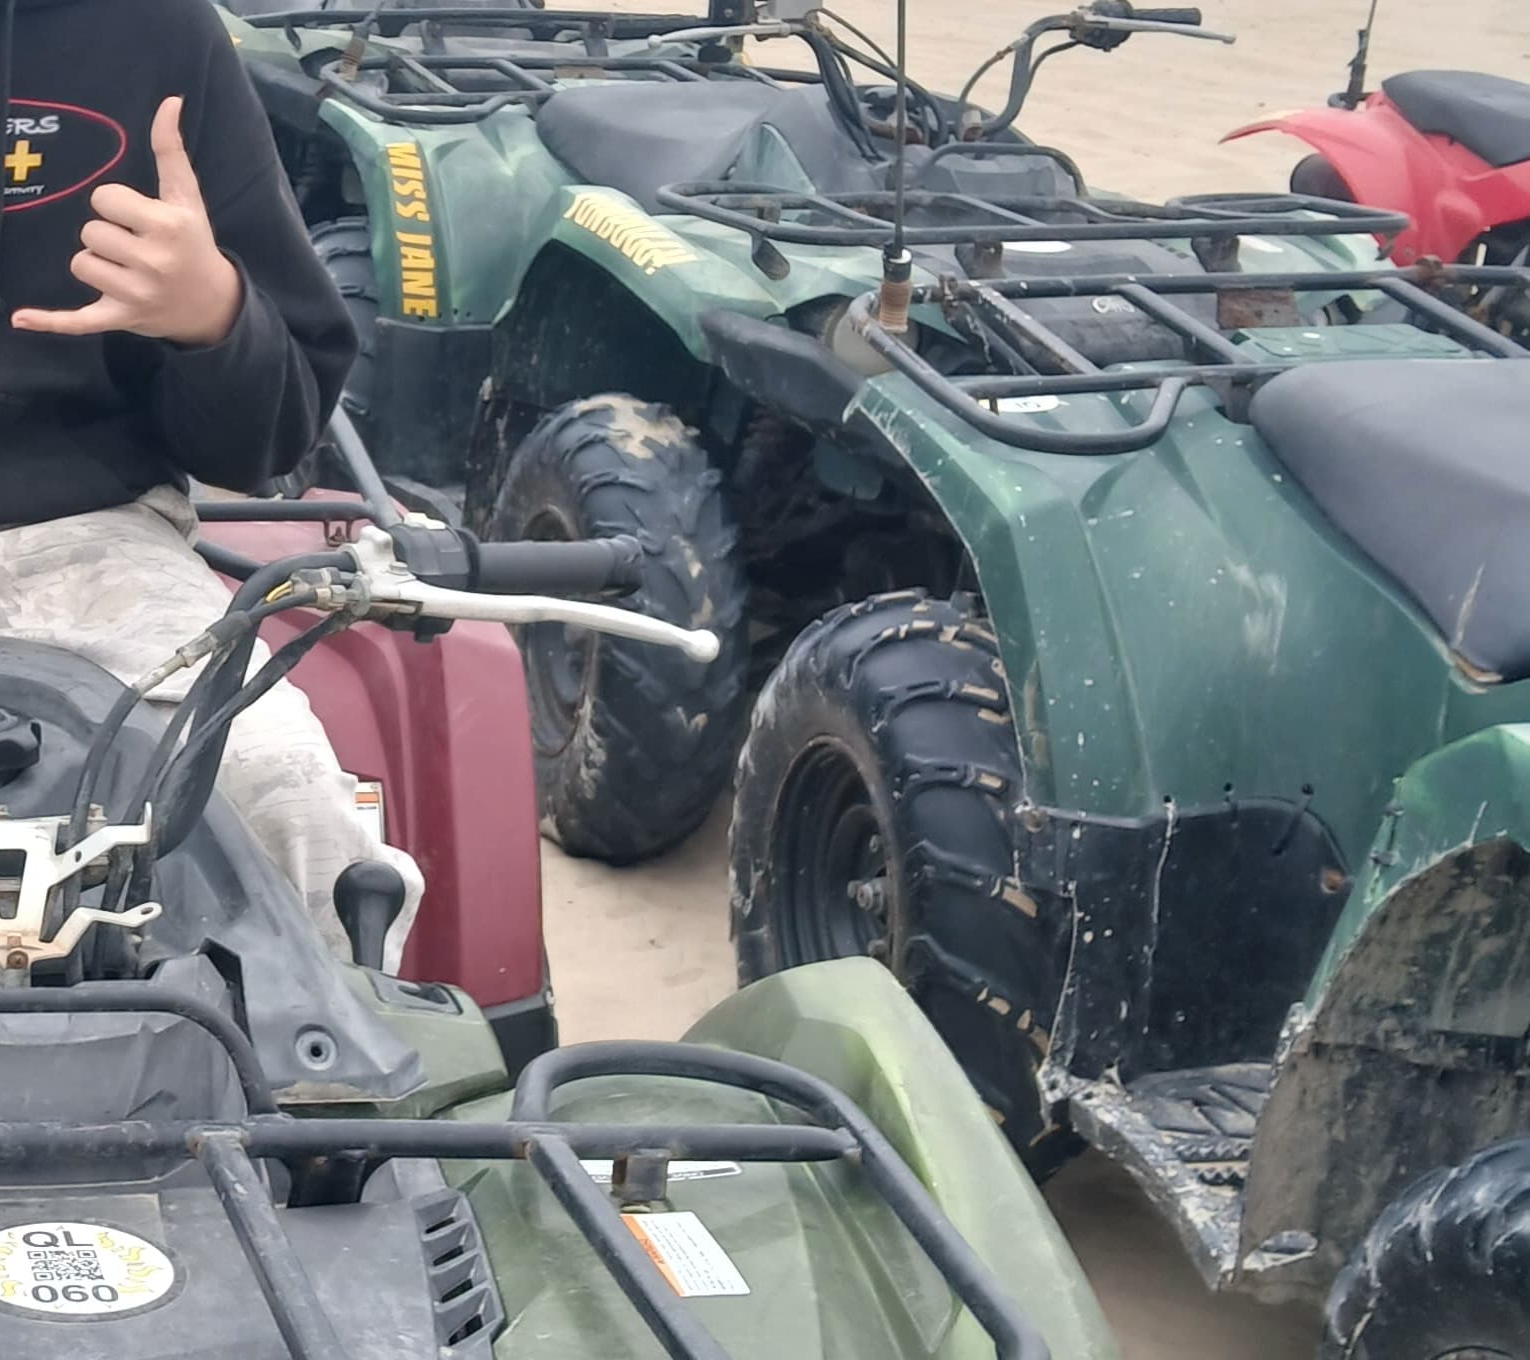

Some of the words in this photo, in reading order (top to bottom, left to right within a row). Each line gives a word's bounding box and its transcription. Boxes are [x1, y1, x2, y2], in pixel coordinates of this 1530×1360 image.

[386, 142, 432, 223] MISS
[394, 231, 439, 318] JANE
[22, 1230, 94, 1248] QL
[31, 1283, 119, 1303] 060
